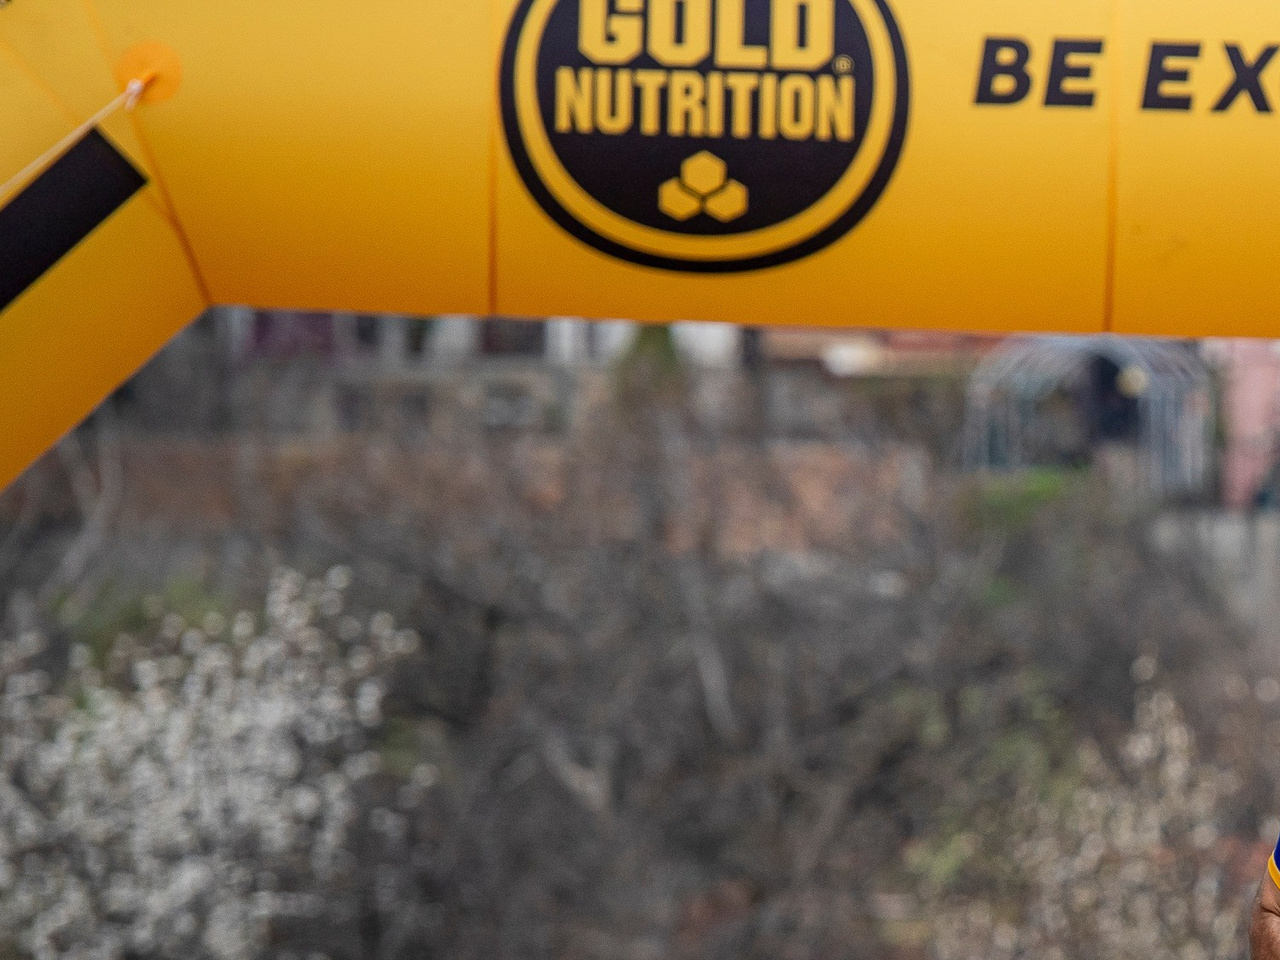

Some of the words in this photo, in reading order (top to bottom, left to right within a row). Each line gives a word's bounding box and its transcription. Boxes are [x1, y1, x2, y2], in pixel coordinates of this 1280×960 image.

[577, 0, 836, 71] GOLD
[553, 65, 857, 143] NUTRITION
[973, 37, 1105, 108] BE
